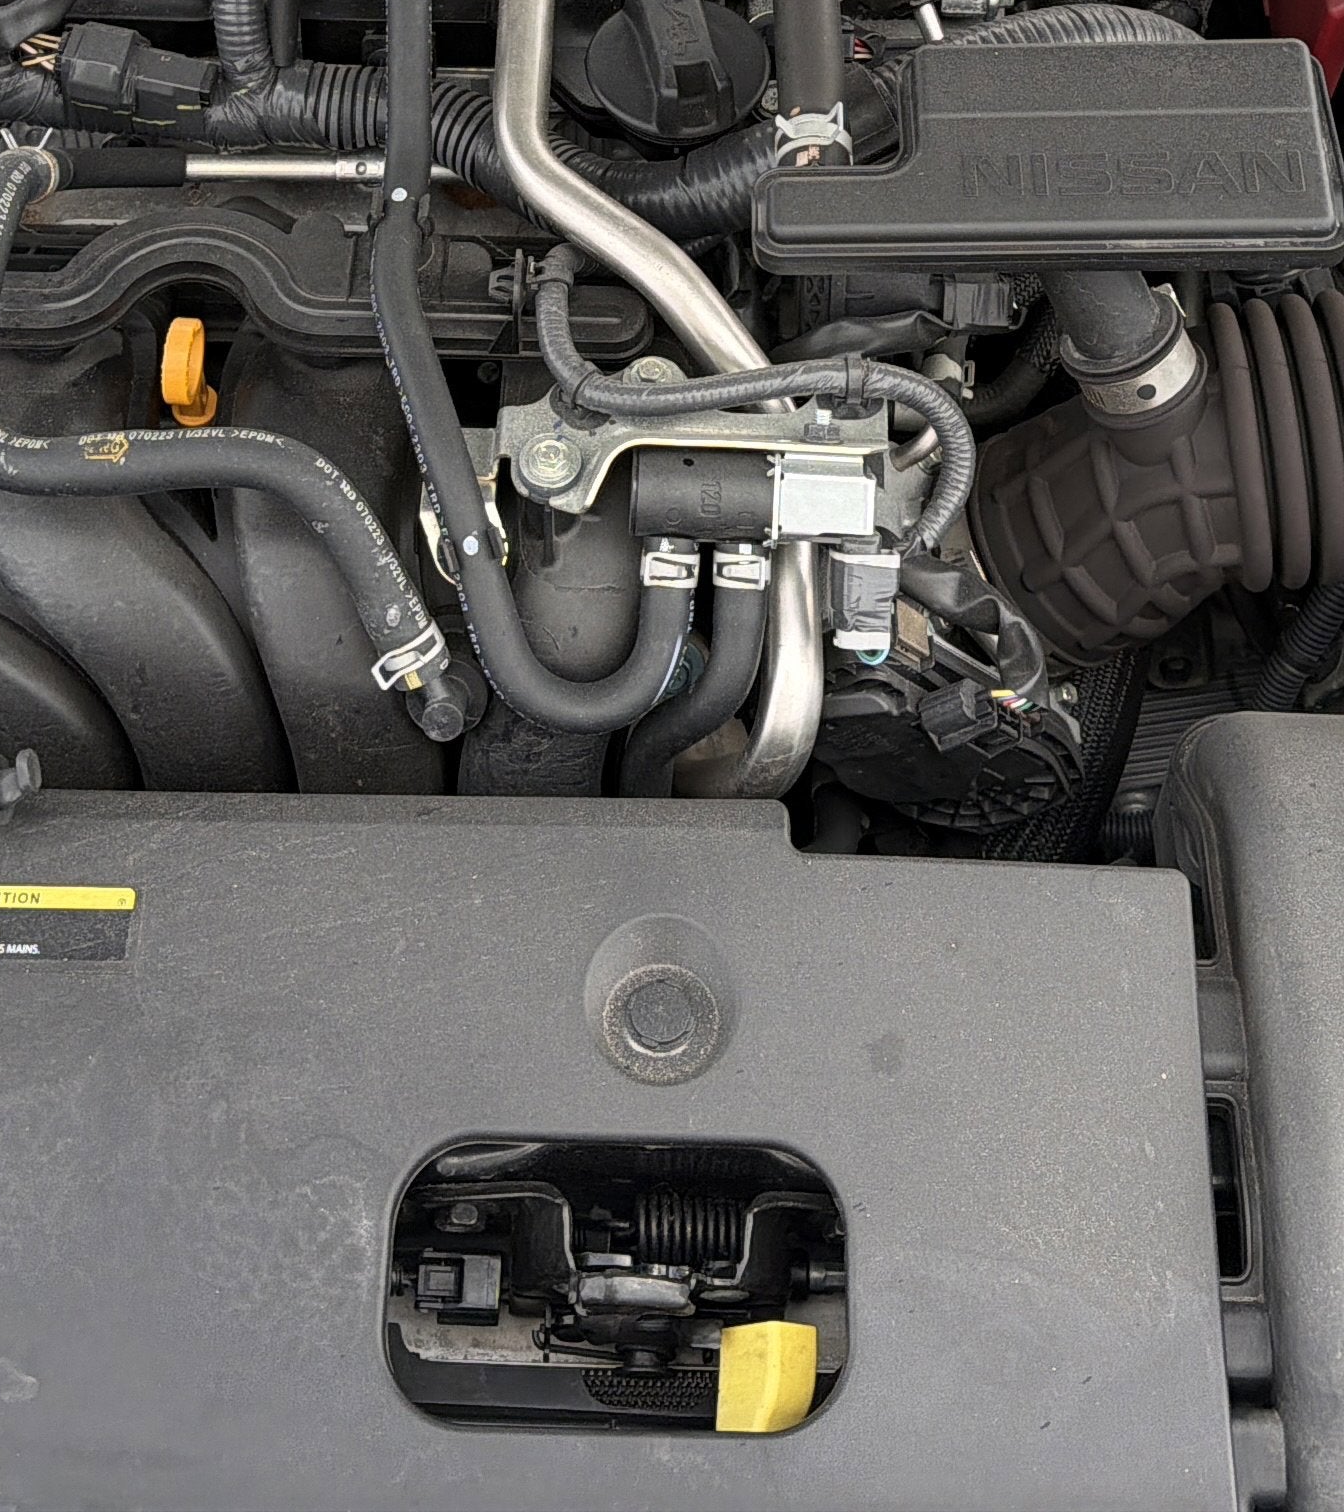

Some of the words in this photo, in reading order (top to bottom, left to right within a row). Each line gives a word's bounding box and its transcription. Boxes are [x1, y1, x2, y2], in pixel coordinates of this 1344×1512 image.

[959, 148, 1306, 199] NISSAN
[315, 457, 340, 479] DOT
[356, 501, 386, 546] 070223
[6, 944, 40, 955] MAINS.
